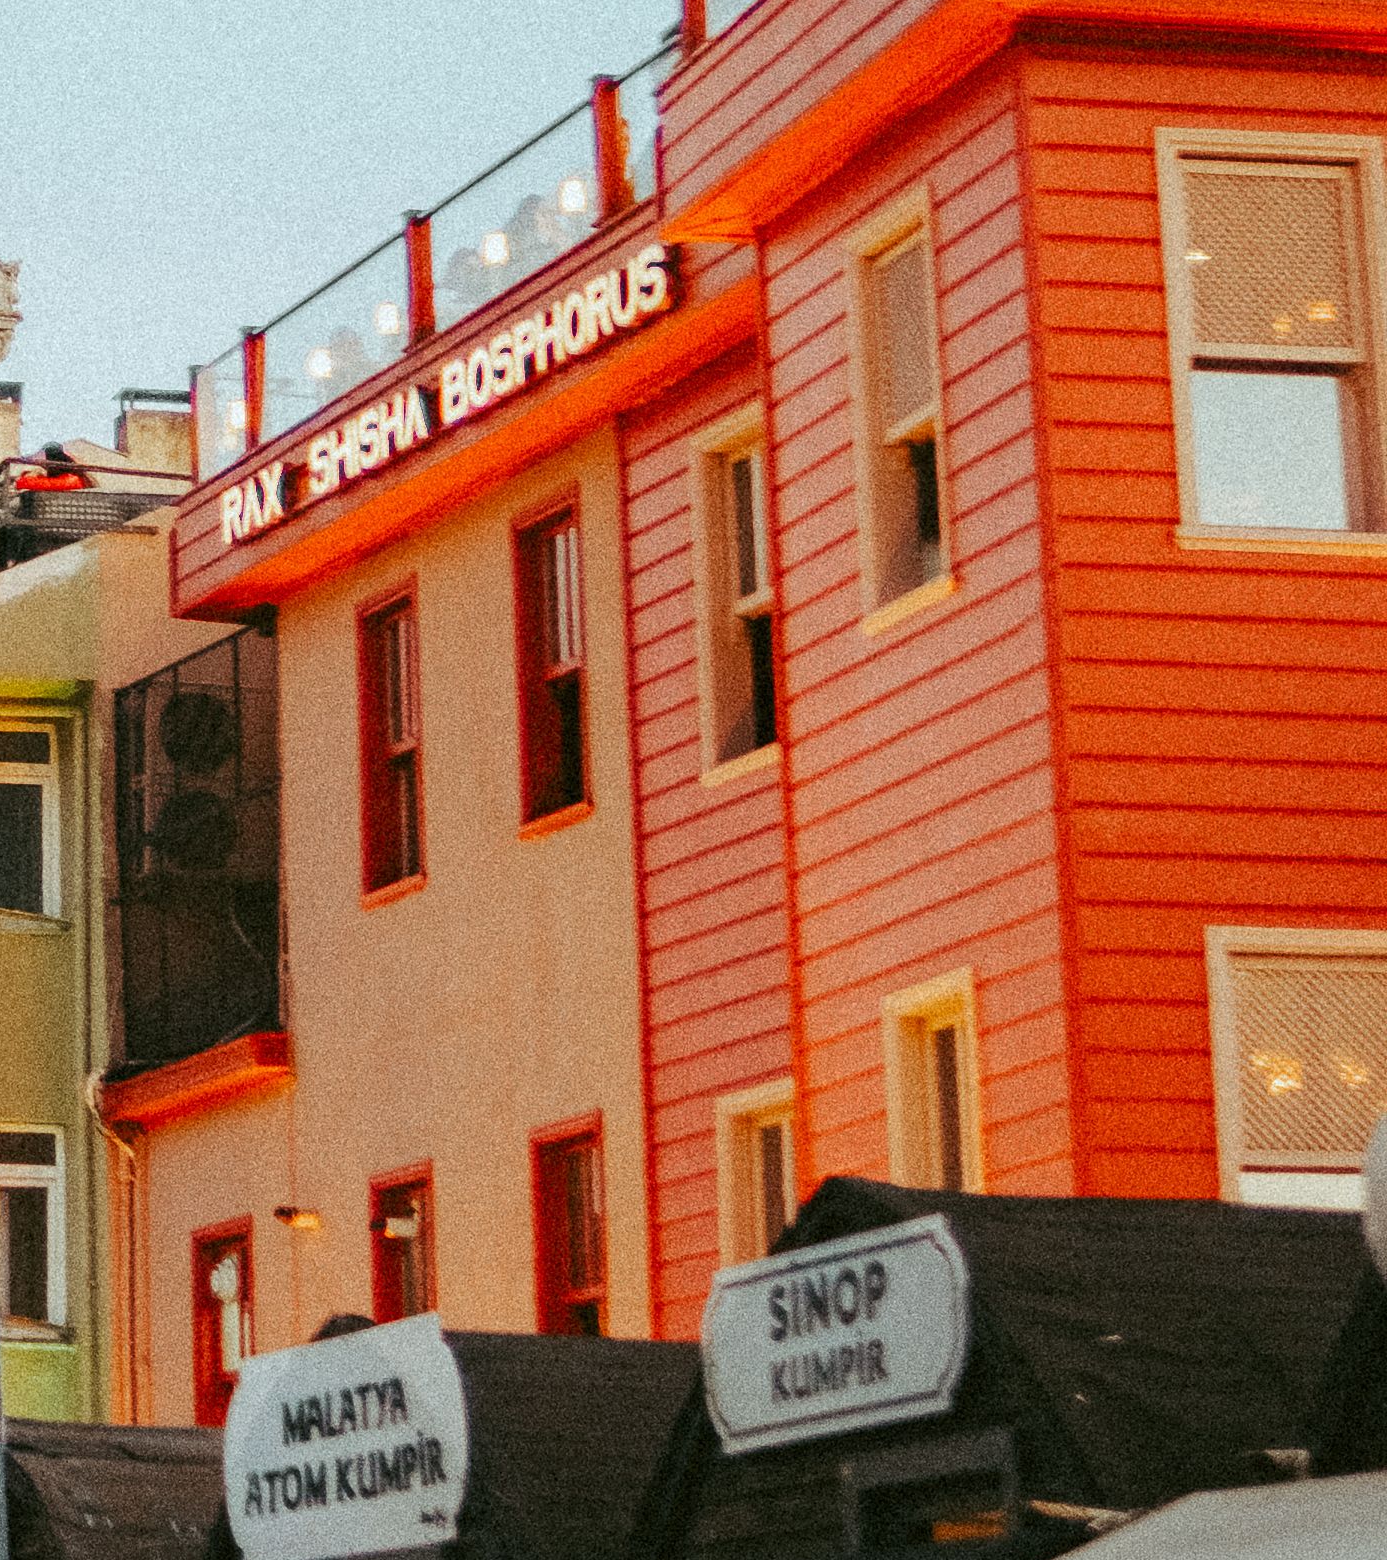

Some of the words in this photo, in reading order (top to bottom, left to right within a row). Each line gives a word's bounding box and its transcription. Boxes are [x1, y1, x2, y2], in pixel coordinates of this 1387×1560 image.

[221, 462, 285, 544] RAX
[307, 384, 431, 494] SHISHA
[439, 244, 668, 425] BOSPHORUS
[282, 1377, 408, 1447] MALATYA
[244, 1461, 327, 1517] ATOM
[335, 1430, 448, 1503] KUMPİR
